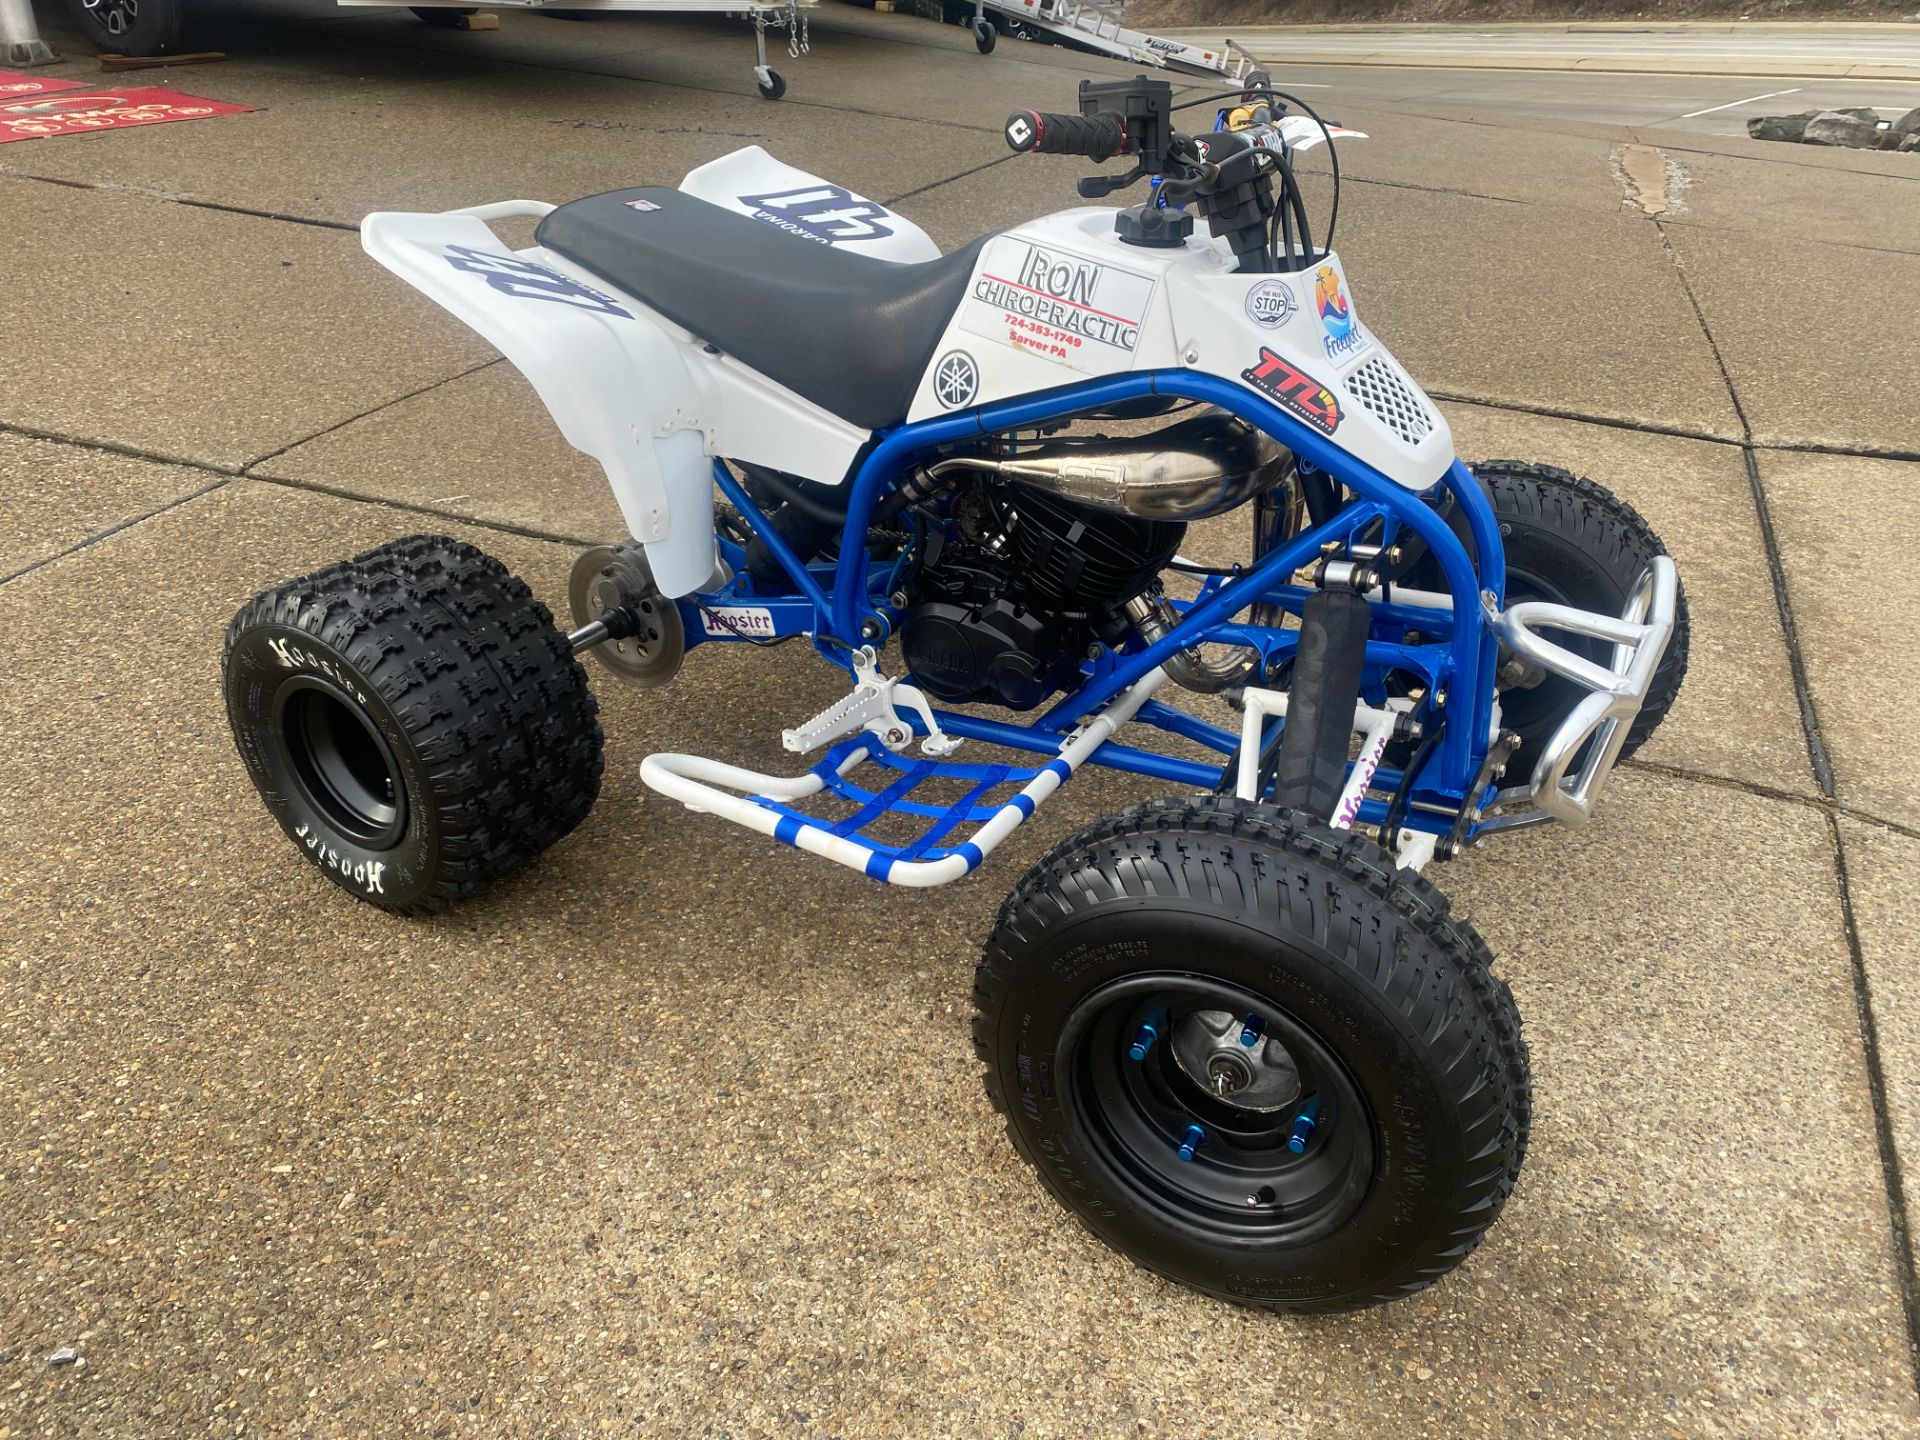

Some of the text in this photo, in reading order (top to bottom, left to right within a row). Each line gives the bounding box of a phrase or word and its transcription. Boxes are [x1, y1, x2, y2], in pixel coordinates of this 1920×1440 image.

[1, 104, 172, 126] KYMCO
[1017, 244, 1105, 306] IRON
[974, 279, 1139, 349] CHIROPRACTIC
[1255, 297, 1285, 312] STOP
[1004, 314, 1082, 348] 724-353-1749
[1009, 330, 1067, 358] Sarver PA
[1323, 321, 1362, 359] Freeport
[1253, 349, 1323, 415] TTL
[1245, 372, 1333, 431] TO THE LIMIT MOTORSPORTS
